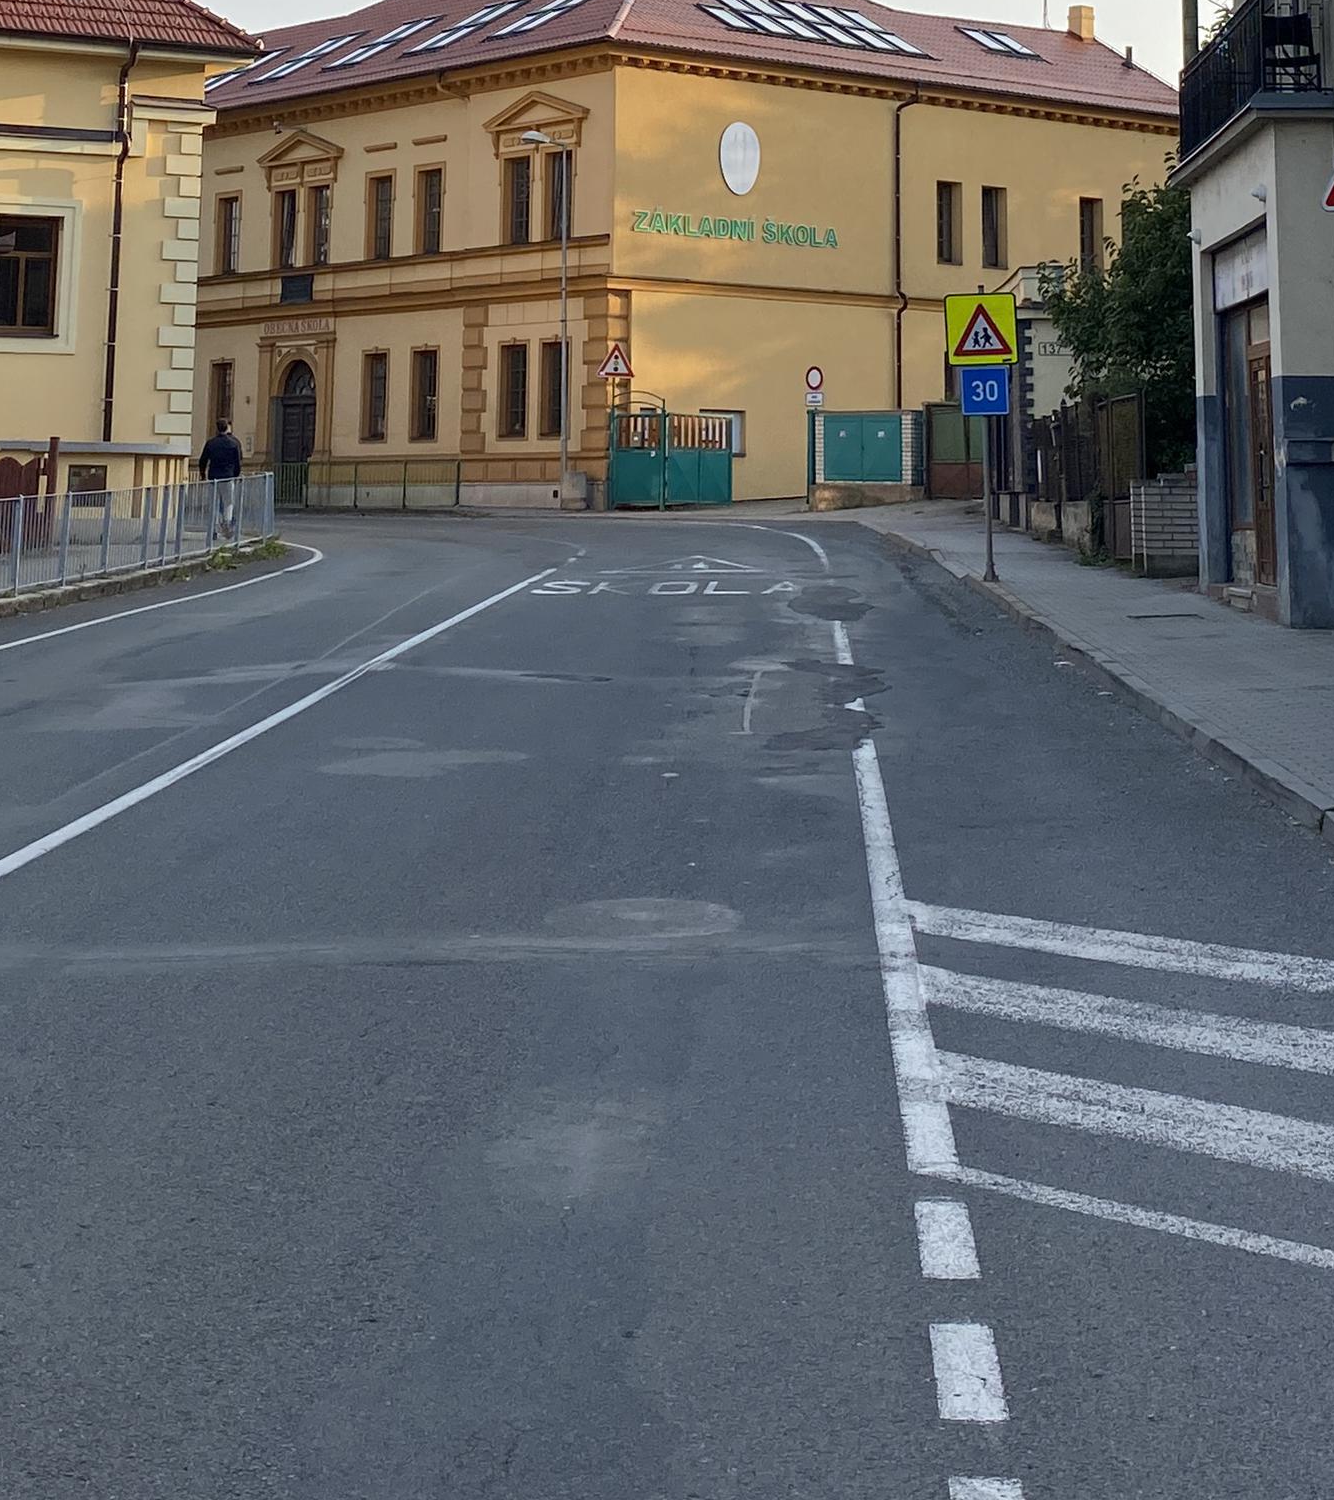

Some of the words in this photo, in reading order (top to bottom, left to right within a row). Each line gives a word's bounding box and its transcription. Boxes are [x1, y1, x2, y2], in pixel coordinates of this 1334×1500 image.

[633, 206, 756, 242] ZÁKLADNÍ
[762, 212, 839, 248] ŠKOLA
[971, 380, 998, 401] 30
